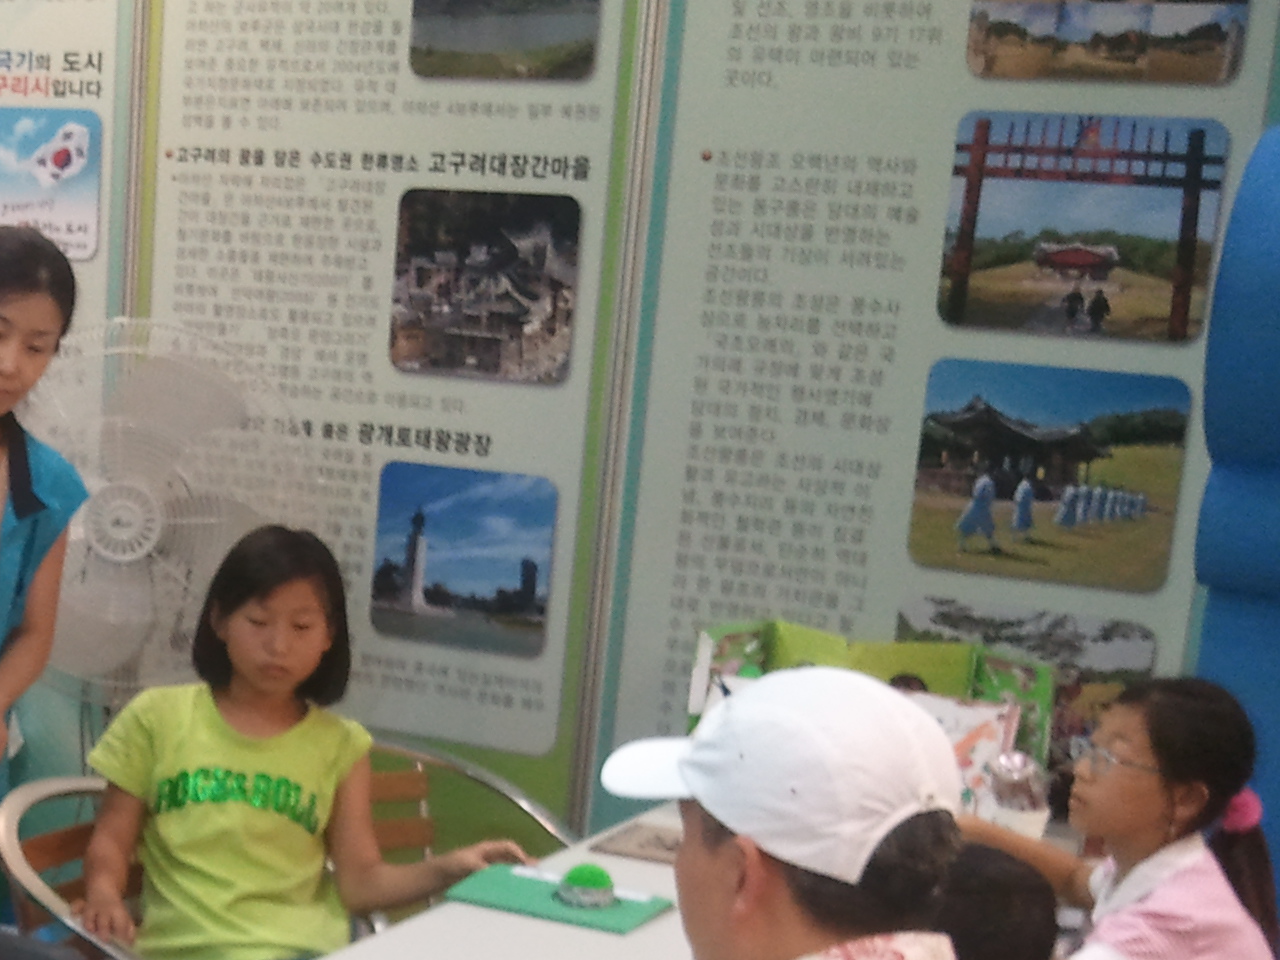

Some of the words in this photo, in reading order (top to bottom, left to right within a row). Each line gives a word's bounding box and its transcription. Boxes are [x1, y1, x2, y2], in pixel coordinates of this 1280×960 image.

[61, 50, 103, 75] 도시
[176, 147, 231, 165] 고구려의
[310, 150, 353, 171] 수도권
[361, 152, 419, 173] 한류명소
[428, 151, 591, 182] 고구려대장간마을
[358, 421, 492, 457] 광개토태왕광장
